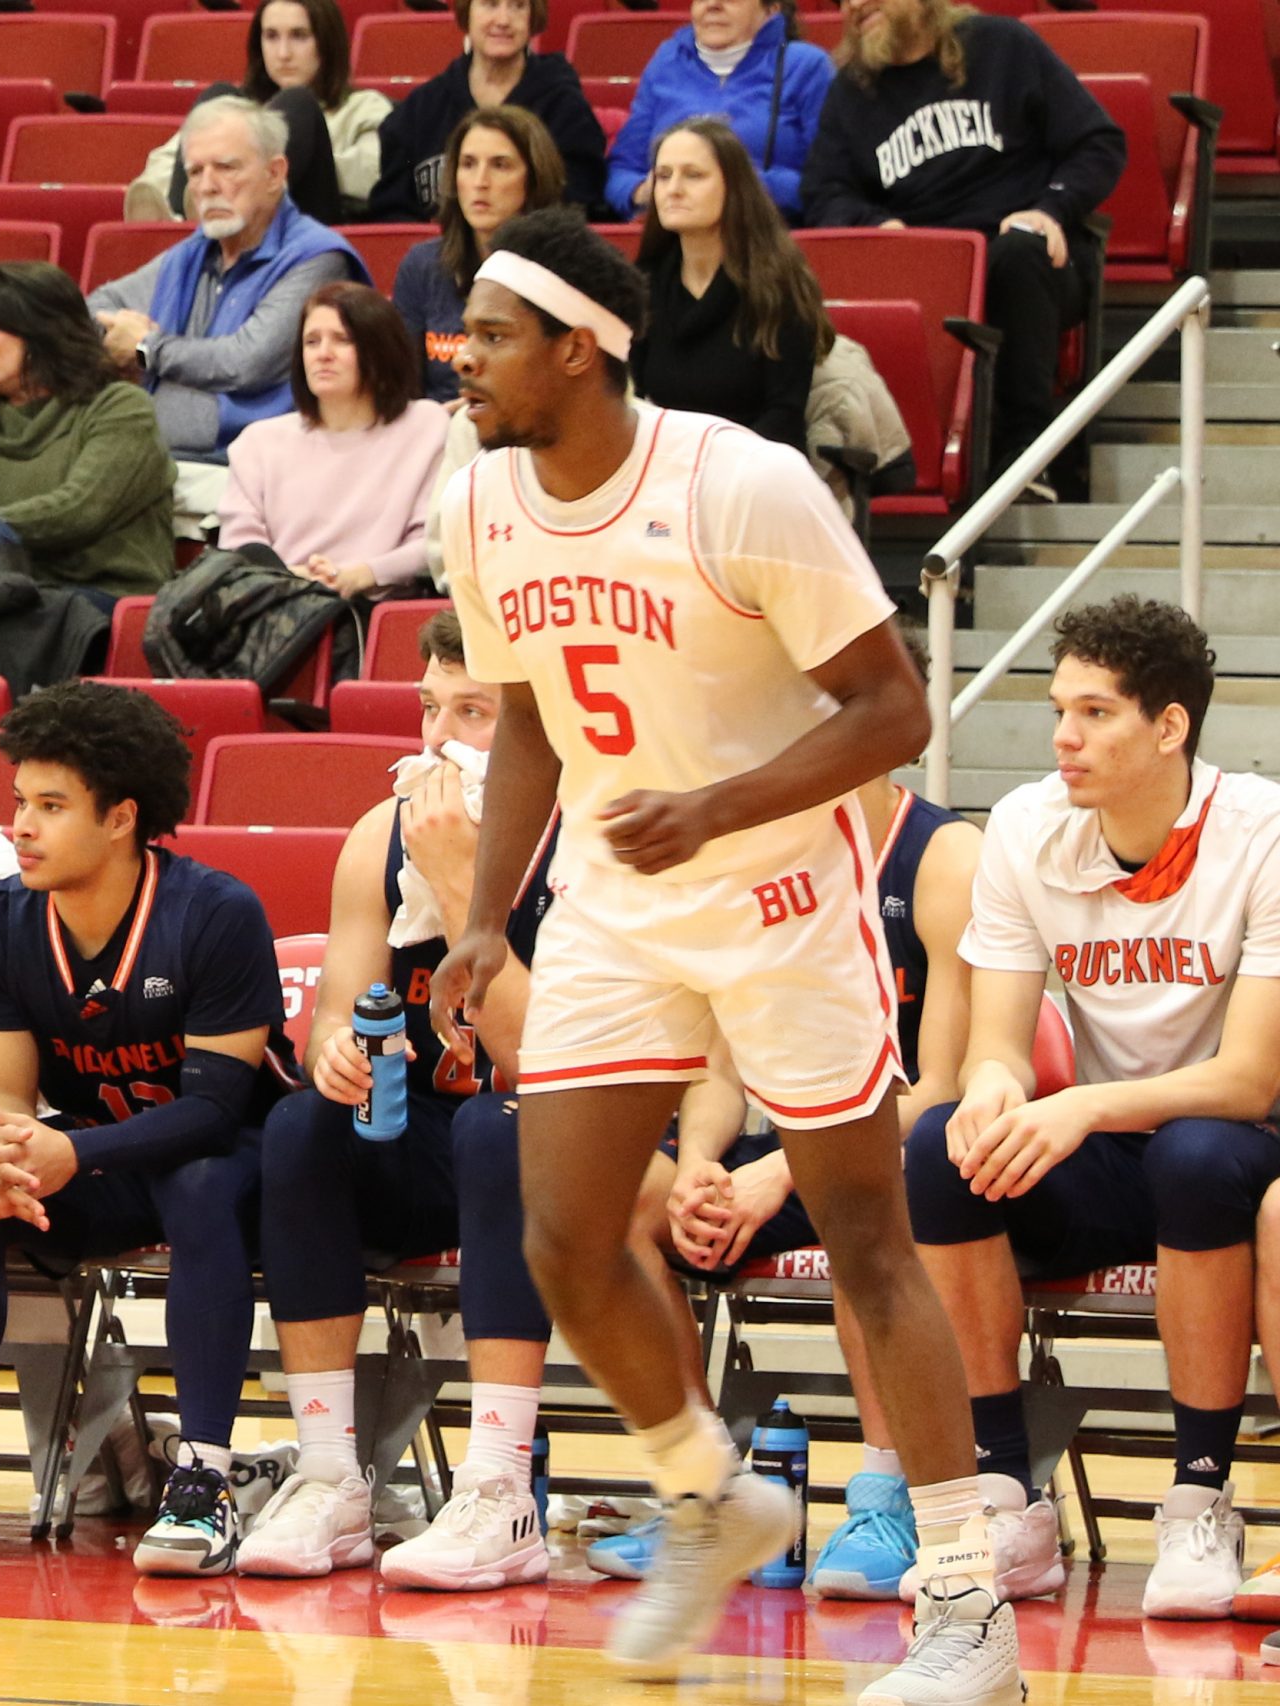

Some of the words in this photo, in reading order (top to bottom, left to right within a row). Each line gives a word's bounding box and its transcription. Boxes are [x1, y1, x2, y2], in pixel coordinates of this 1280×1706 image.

[498, 575, 677, 651] BOSTON
[562, 644, 637, 757] 5
[752, 870, 818, 928] BU
[1055, 937, 1226, 988] BUCKNEL
